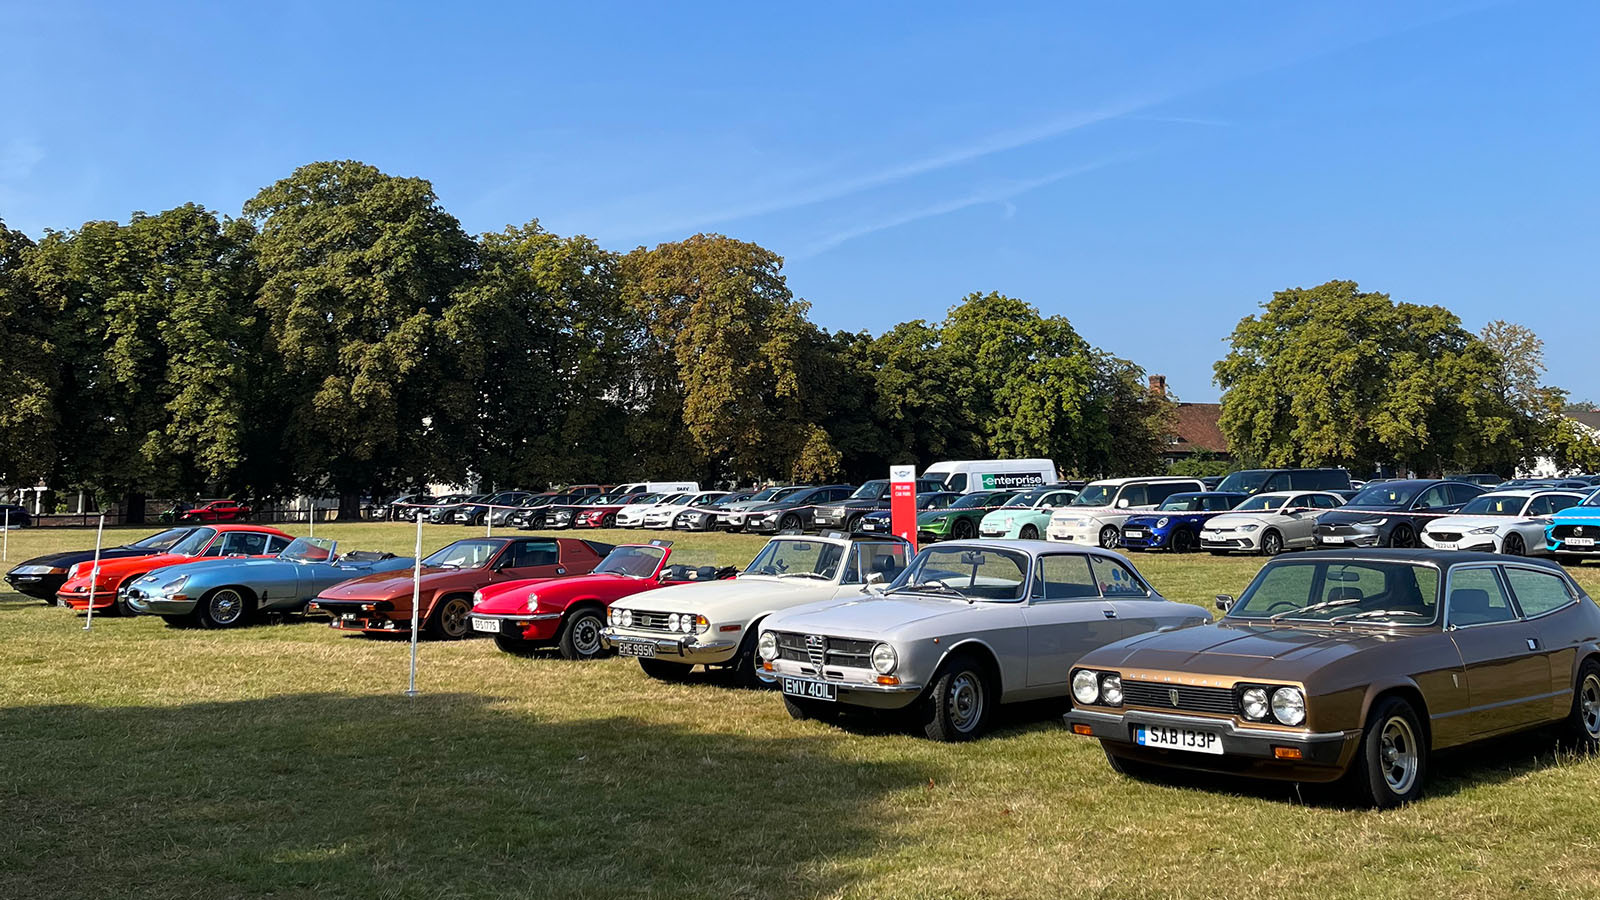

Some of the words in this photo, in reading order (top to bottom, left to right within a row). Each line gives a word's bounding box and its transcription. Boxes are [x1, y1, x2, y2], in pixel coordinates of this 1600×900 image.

[985, 475, 1042, 487] enterprise
[633, 644, 654, 657] 995K
[785, 679, 806, 695] EWV
[808, 682, 833, 699] 401L
[1150, 726, 1178, 745] SAB
[1183, 730, 1216, 749] 133P
